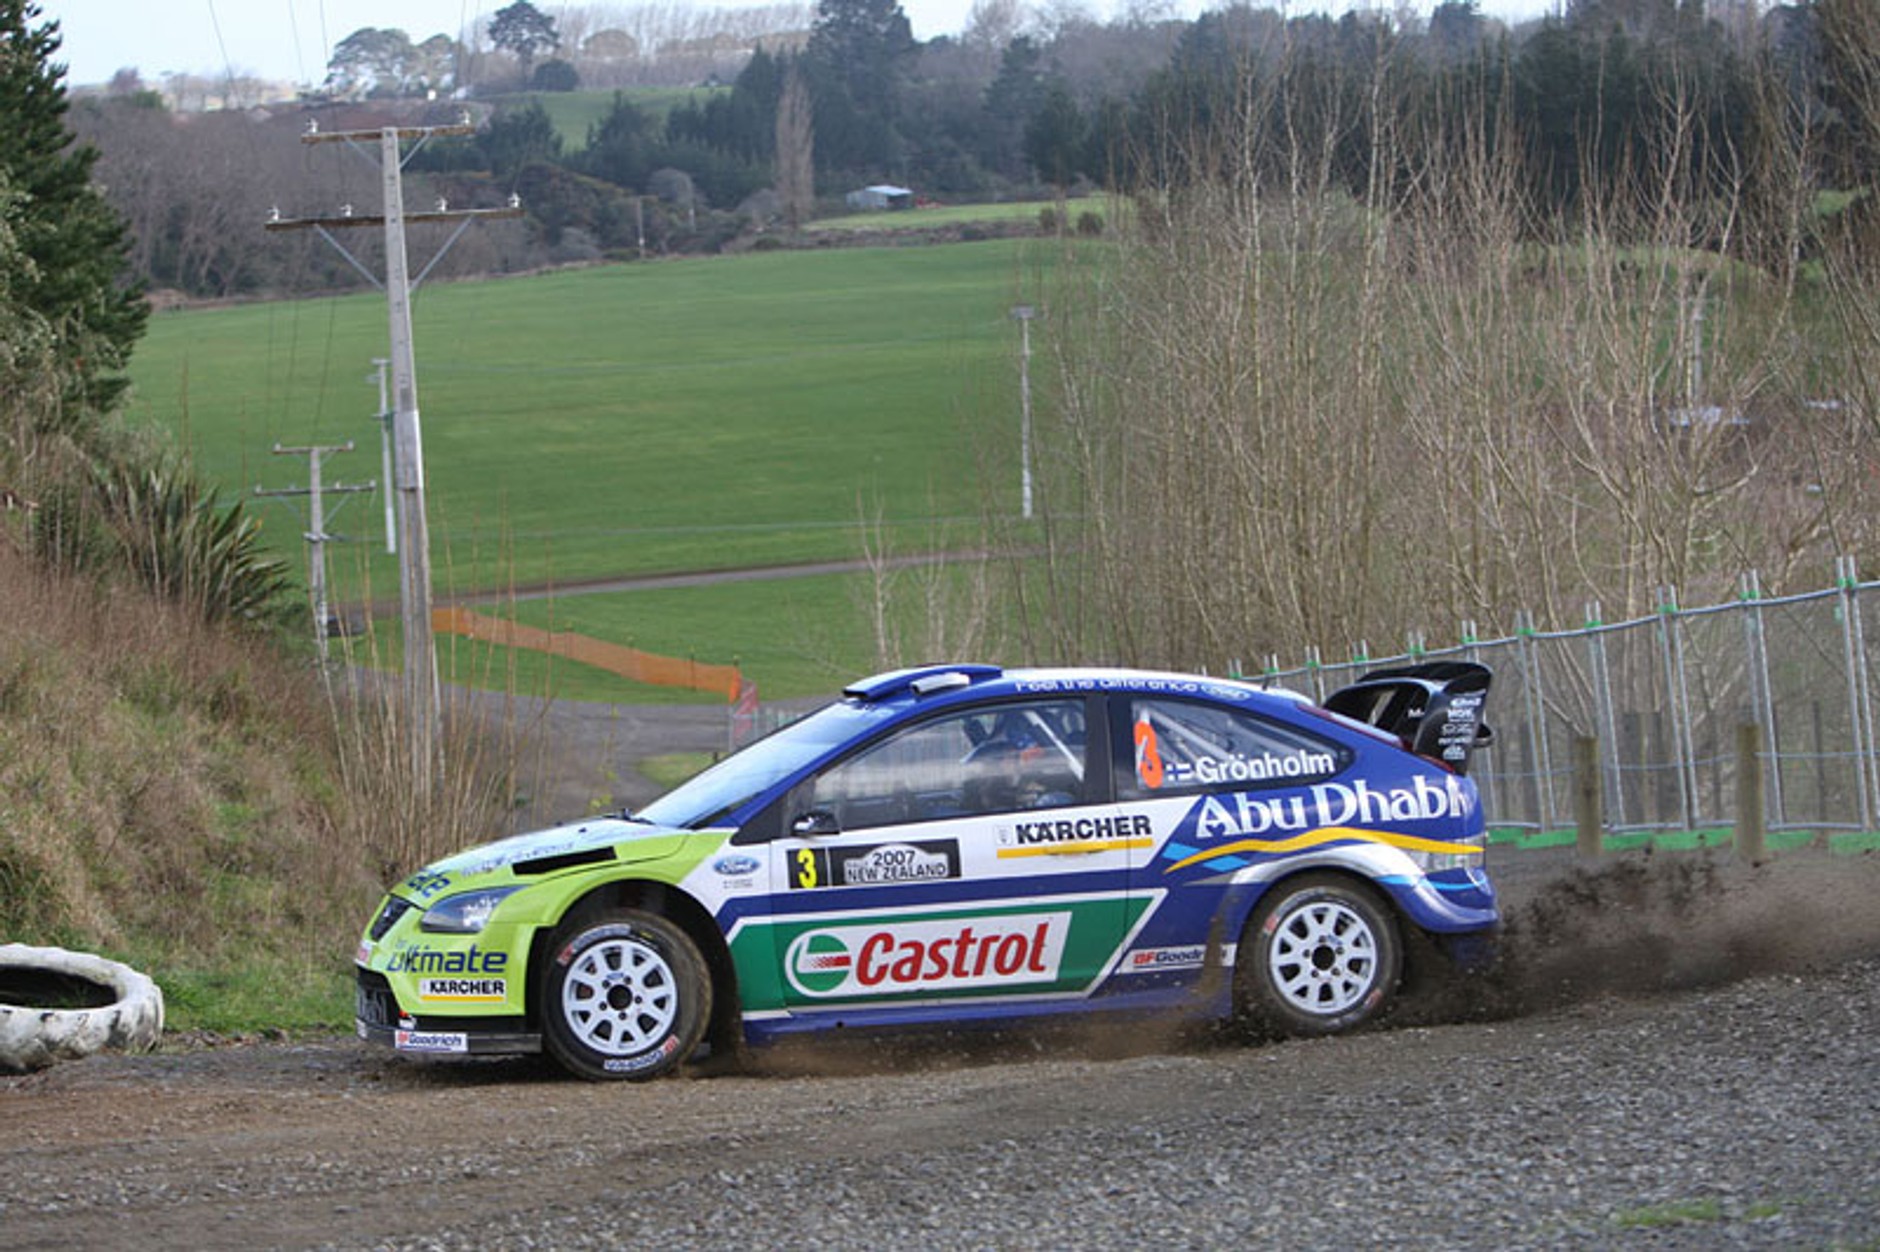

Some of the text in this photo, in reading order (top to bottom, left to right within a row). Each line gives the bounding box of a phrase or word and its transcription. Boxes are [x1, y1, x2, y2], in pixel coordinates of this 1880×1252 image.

[1135, 719, 1163, 790] 3
[1196, 749, 1336, 783] Grönholm
[1015, 815, 1153, 845] KÄRCHER
[1196, 791, 1308, 838] Abu
[797, 847, 817, 889] 3
[847, 866, 878, 881] NEW
[883, 863, 946, 880] ZEALAND
[873, 849, 916, 867] 2007
[856, 920, 1050, 987] Castrol
